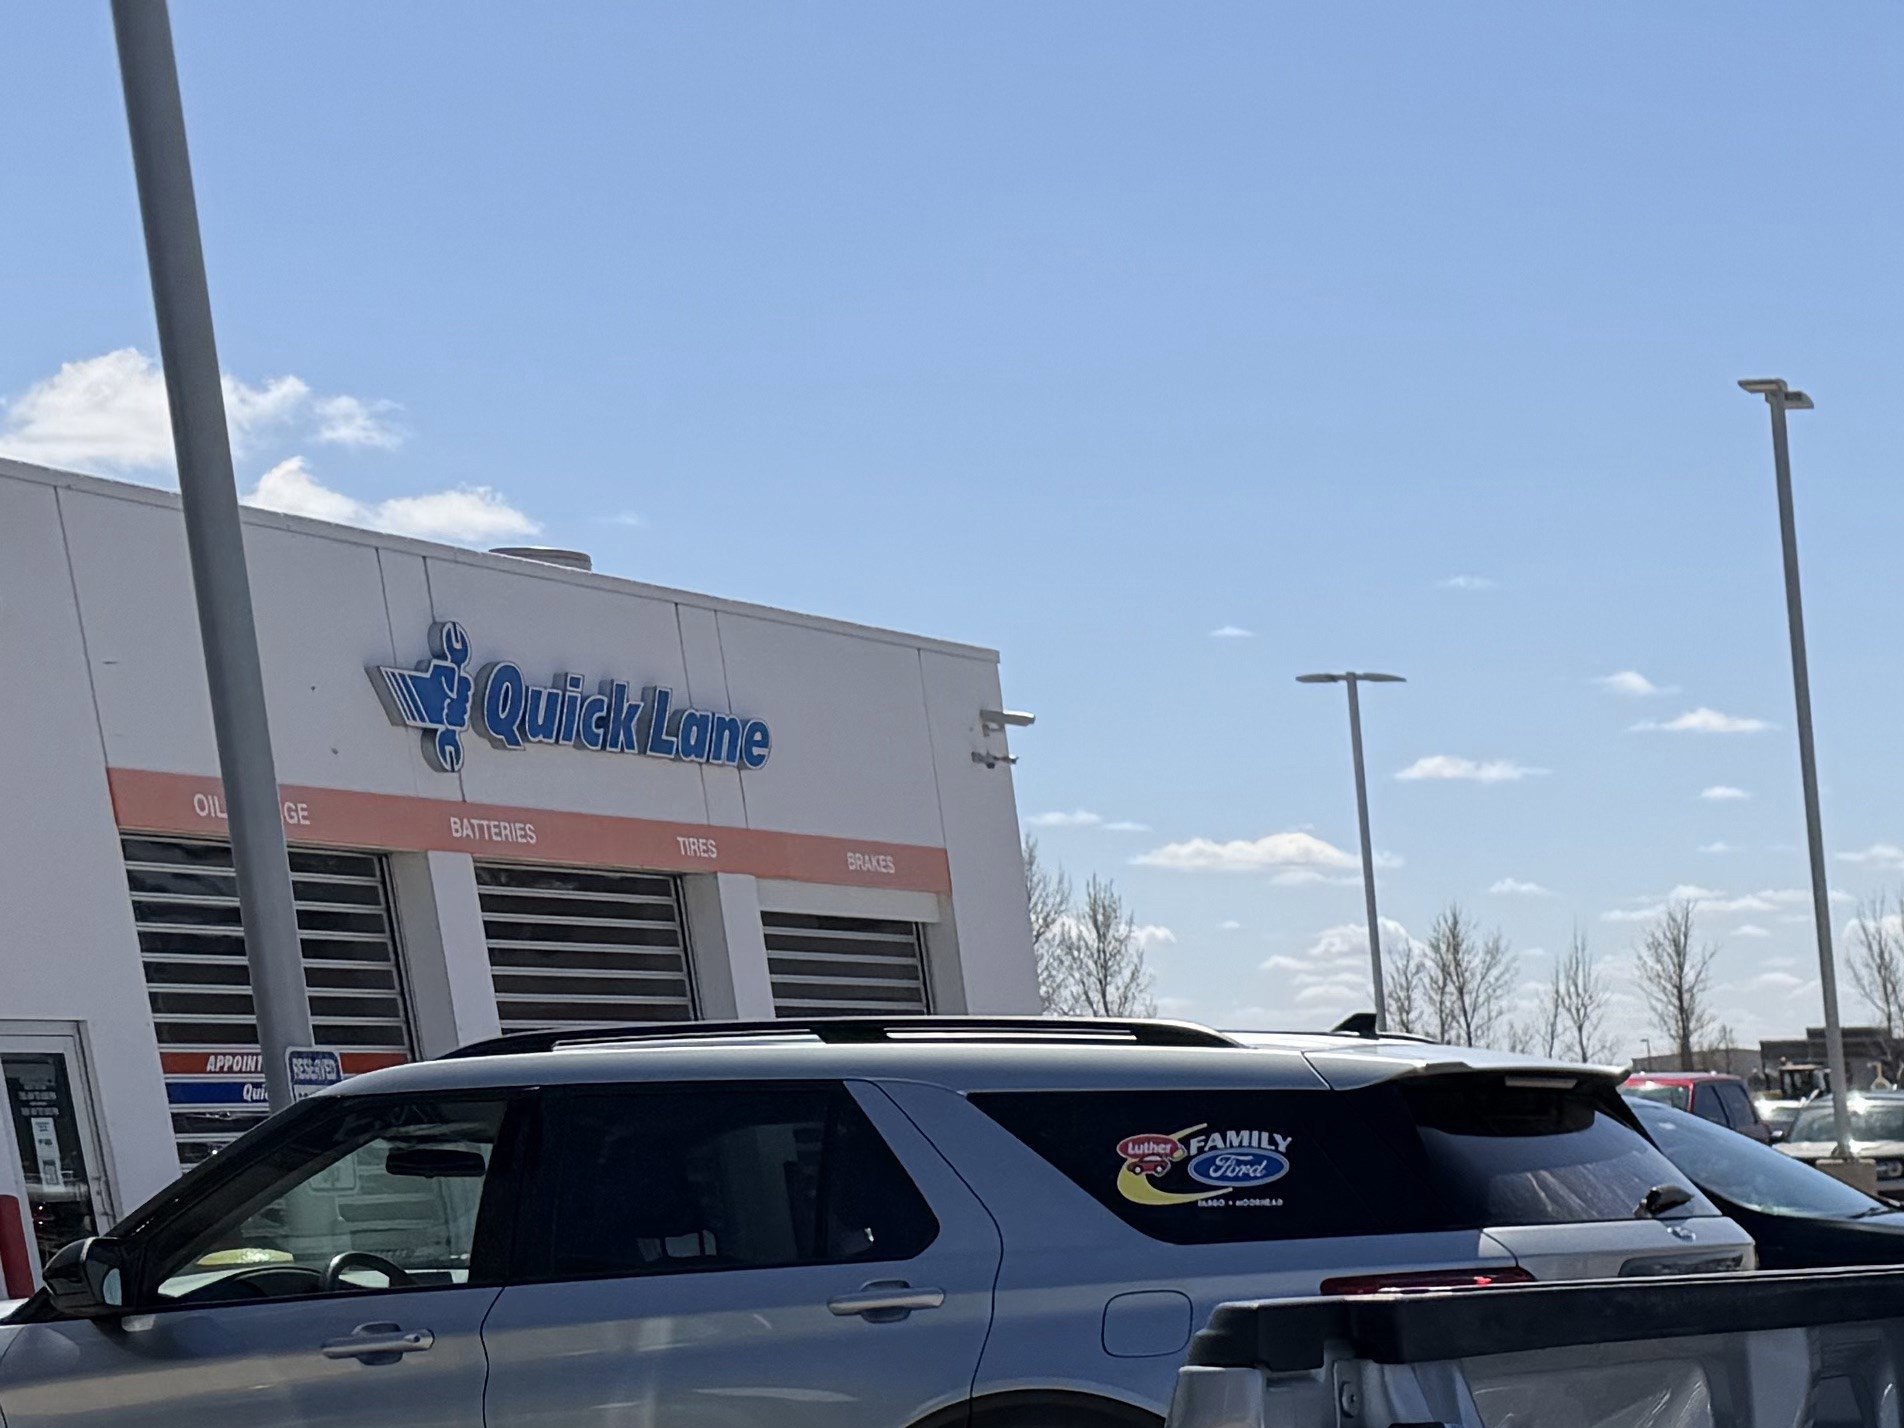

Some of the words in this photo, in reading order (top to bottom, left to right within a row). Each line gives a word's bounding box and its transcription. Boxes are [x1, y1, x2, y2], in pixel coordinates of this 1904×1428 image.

[478, 660, 645, 753] Quick
[644, 685, 772, 770] Lane
[193, 793, 229, 819] OIL
[450, 816, 537, 844] BATTERIES
[676, 836, 718, 859] TIRES
[846, 852, 896, 874] BRAKES
[206, 1055, 263, 1072] APPOINT
[1127, 1141, 1173, 1155] Luther
[1189, 1130, 1292, 1156] FAMILY
[1209, 1154, 1268, 1178] Ford
